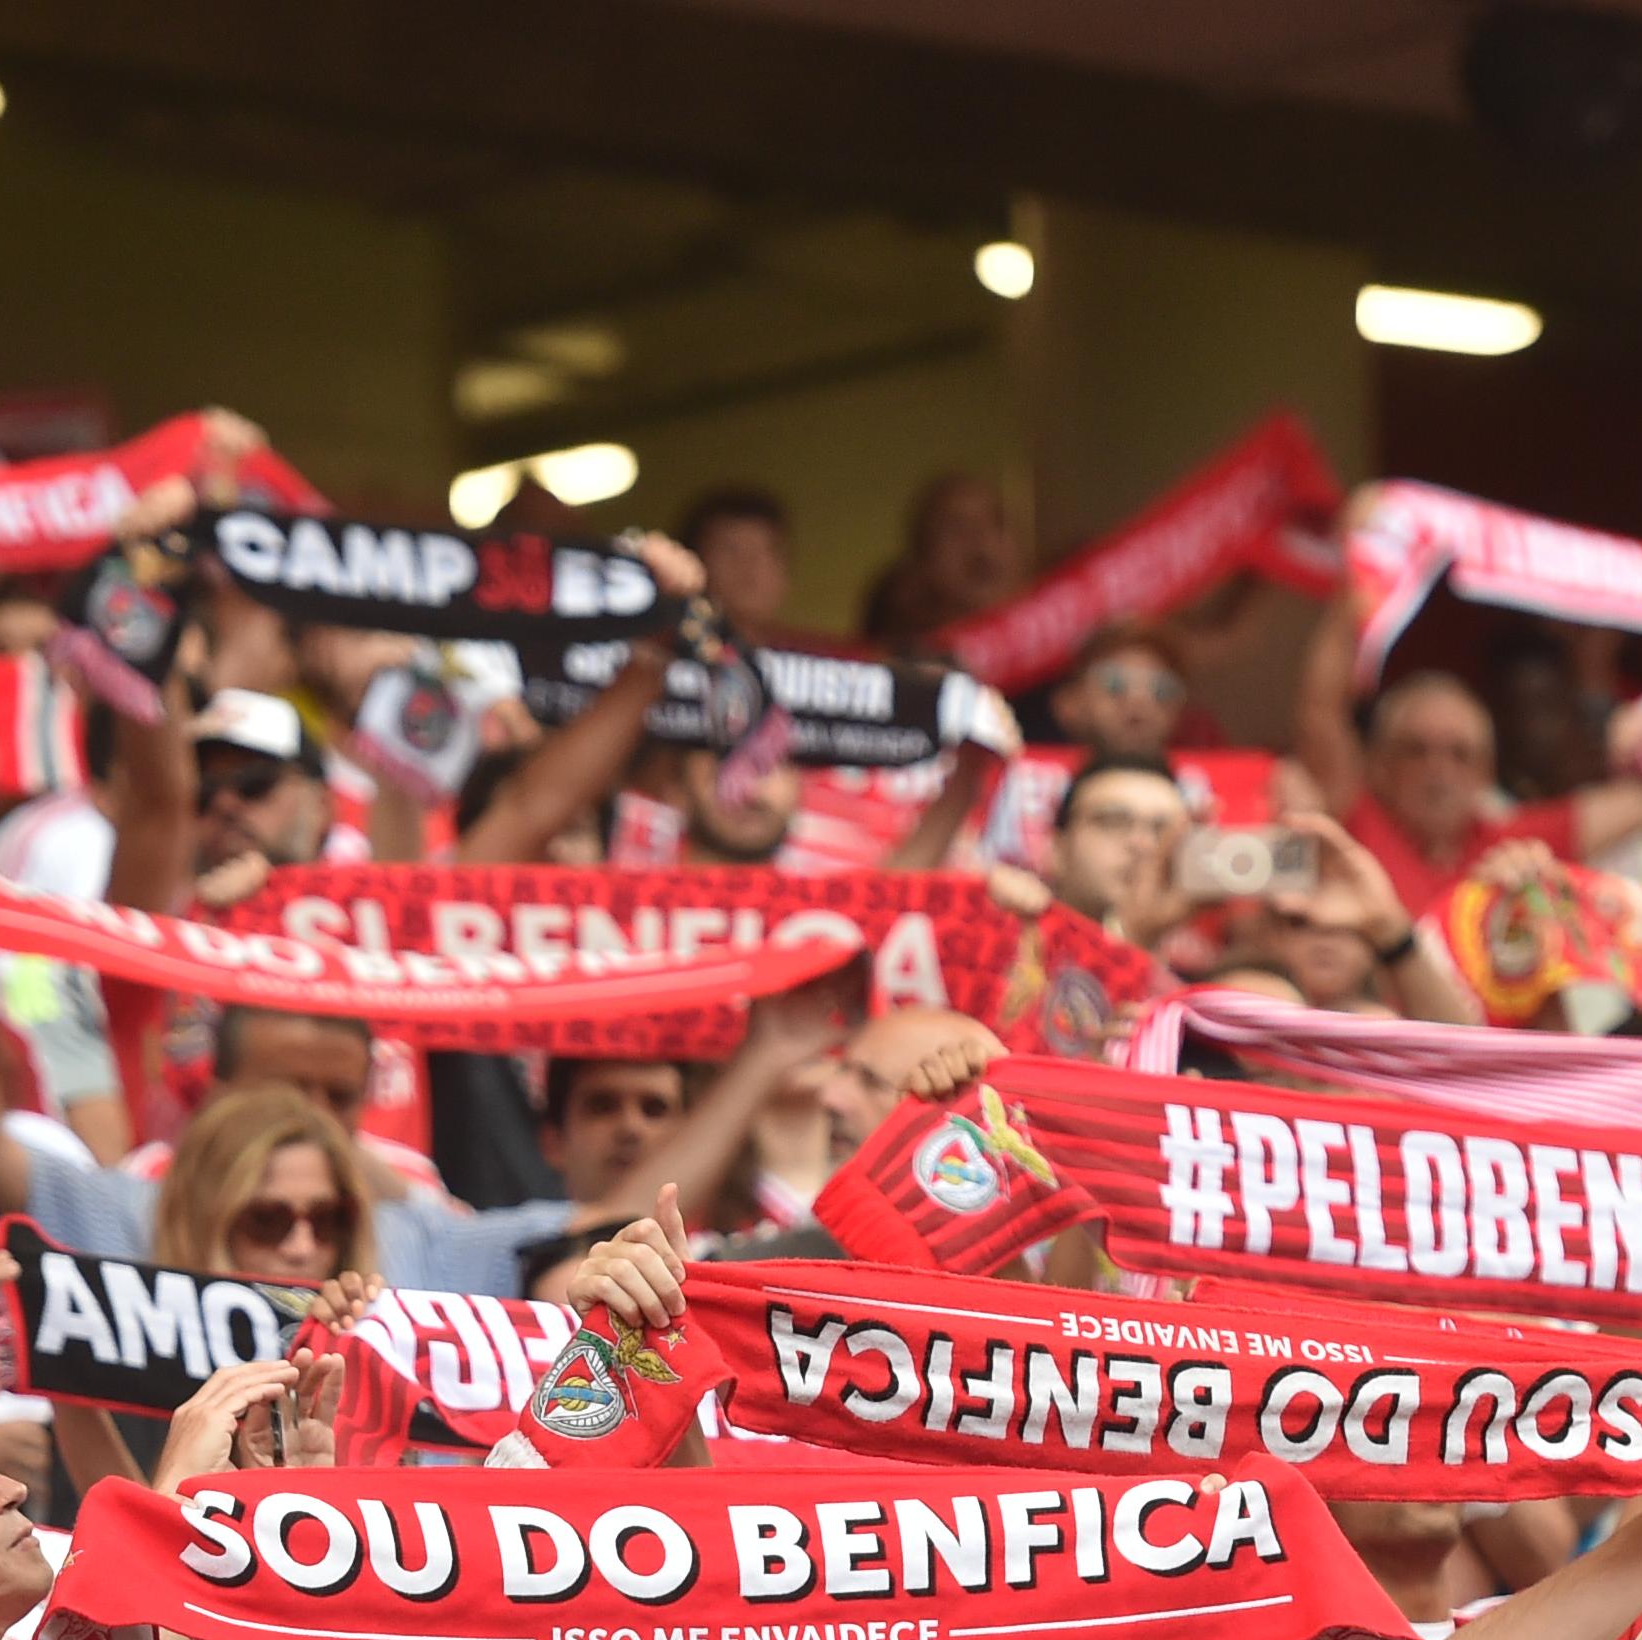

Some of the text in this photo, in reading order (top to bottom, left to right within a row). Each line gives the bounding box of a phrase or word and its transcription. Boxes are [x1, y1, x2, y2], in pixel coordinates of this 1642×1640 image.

[765, 1303, 1234, 1461] BENFICA
[1060, 1311, 1373, 1364] ISSO ME ENVAIDECE
[1259, 1360, 1422, 1466] DO
[179, 1478, 1283, 1606] SOU DO BENFICA
